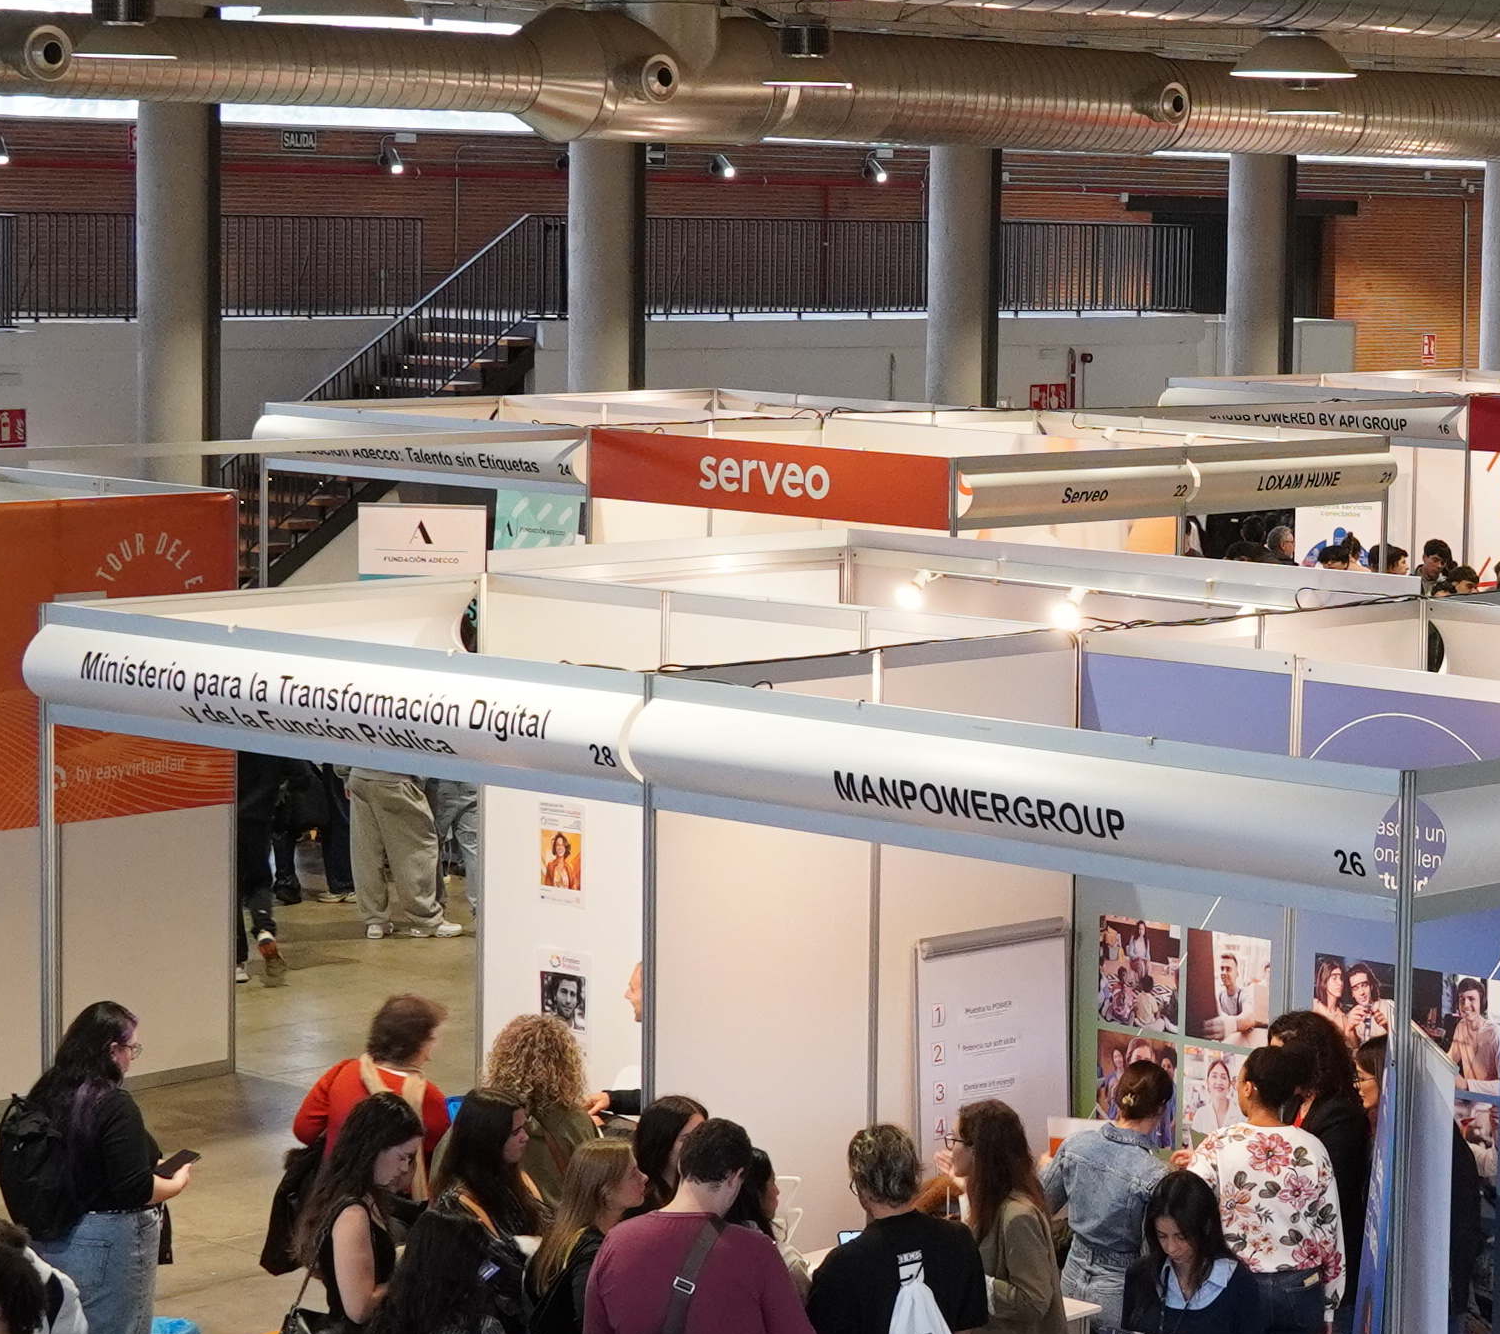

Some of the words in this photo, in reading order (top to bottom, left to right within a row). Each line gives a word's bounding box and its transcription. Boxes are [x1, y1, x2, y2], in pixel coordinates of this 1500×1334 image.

[283, 132, 316, 147] SALIDA
[1319, 414, 1336, 427] BY
[1340, 415, 1359, 429] API
[1362, 417, 1407, 431] GROUP
[1438, 424, 1450, 434] 16
[405, 447, 451, 466] Talento
[456, 452, 476, 468] sin
[478, 453, 540, 475] Etiquetas
[558, 463, 572, 476] 24
[699, 455, 831, 501] serveo
[1257, 474, 1303, 491] LOXAM
[1304, 471, 1341, 489] HUNE
[1378, 472, 1393, 484] 21
[1062, 487, 1109, 505] Serveo
[1173, 484, 1188, 498] 22
[409, 520, 434, 545] A
[96, 533, 145, 582] TOUR
[155, 532, 192, 570] DEL
[383, 555, 426, 564] FUNDACIÓN
[428, 556, 460, 564] ADECCO
[80, 651, 186, 692] Ministerio
[194, 671, 242, 702] para
[250, 671, 269, 703] la
[279, 674, 460, 728] Transformación
[469, 699, 552, 742] Digital
[180, 704, 202, 723] y
[202, 703, 232, 725] de
[231, 706, 260, 728] la
[257, 710, 362, 742] Función
[357, 722, 458, 756] Pública
[589, 743, 617, 768] 28
[77, 765, 92, 783] by
[96, 756, 187, 782] easyvirtualfair
[833, 769, 1126, 841] MANPOWERGROUP
[1333, 848, 1367, 878] 26
[1425, 825, 1445, 843] un
[934, 1007, 942, 1024] 1
[933, 1045, 943, 1063] 2
[935, 1083, 945, 1101] 3
[935, 1118, 945, 1135] 4
